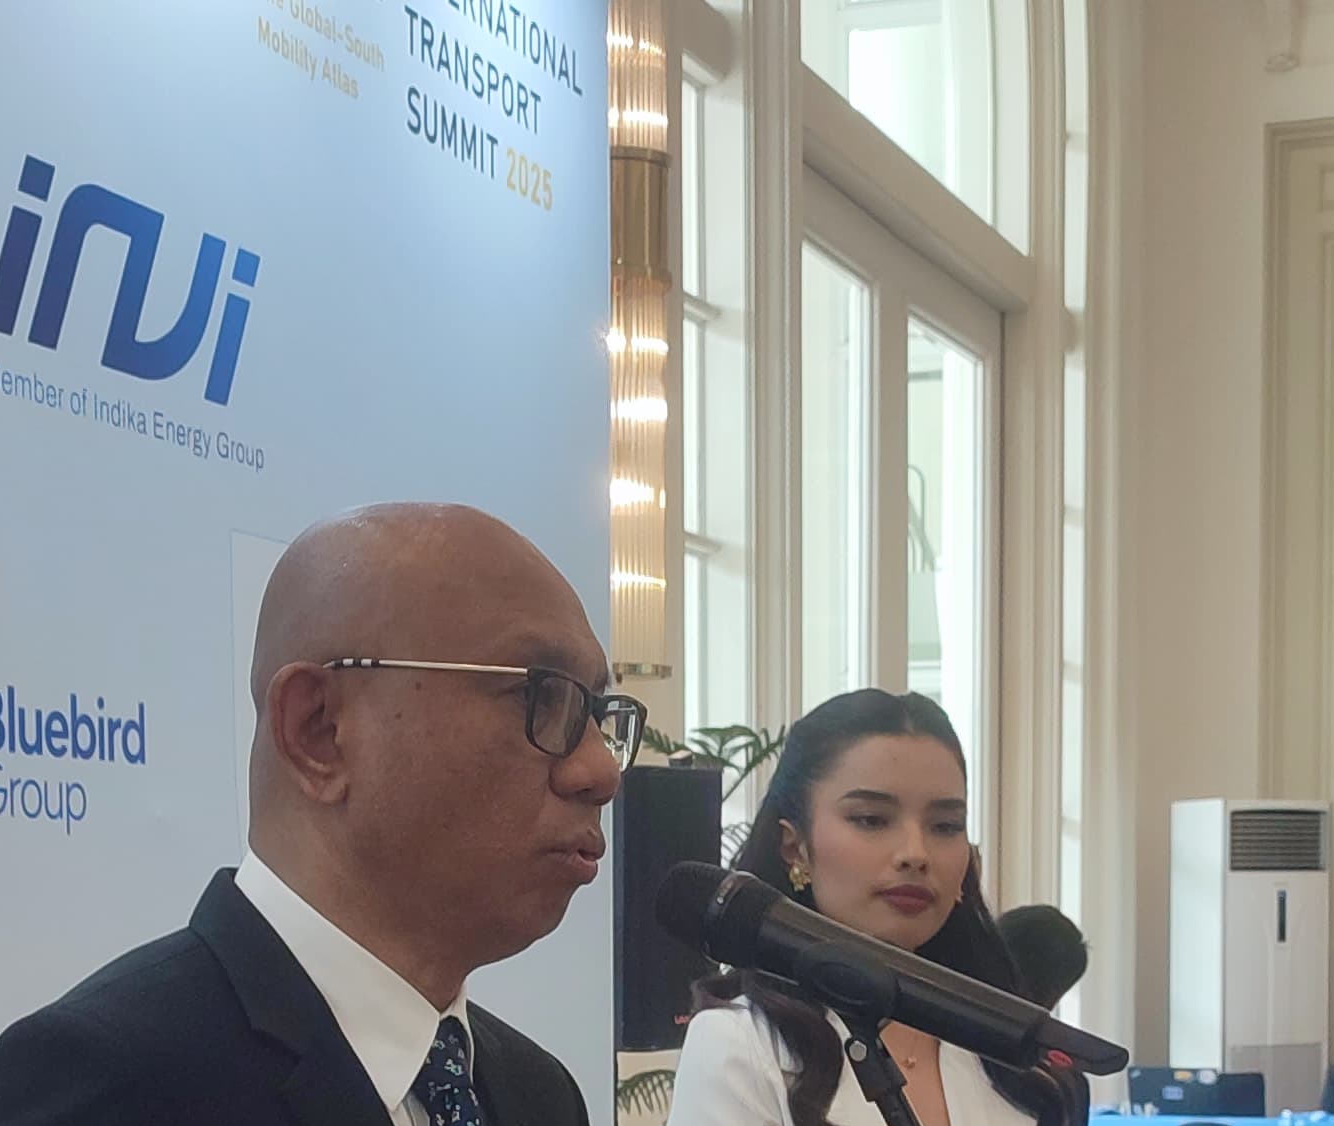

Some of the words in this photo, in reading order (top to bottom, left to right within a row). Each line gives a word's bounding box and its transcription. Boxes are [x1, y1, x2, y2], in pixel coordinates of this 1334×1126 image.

[258, 15, 317, 82] Mobility
[322, 56, 360, 99] Atlas
[405, 5, 541, 134] TRANSPORT
[407, 87, 498, 178] SUMMIT
[506, 147, 553, 211] 2025
[69, 387, 88, 417] of
[93, 392, 148, 436] Indika
[153, 411, 211, 460] Energy
[216, 431, 265, 472] Group
